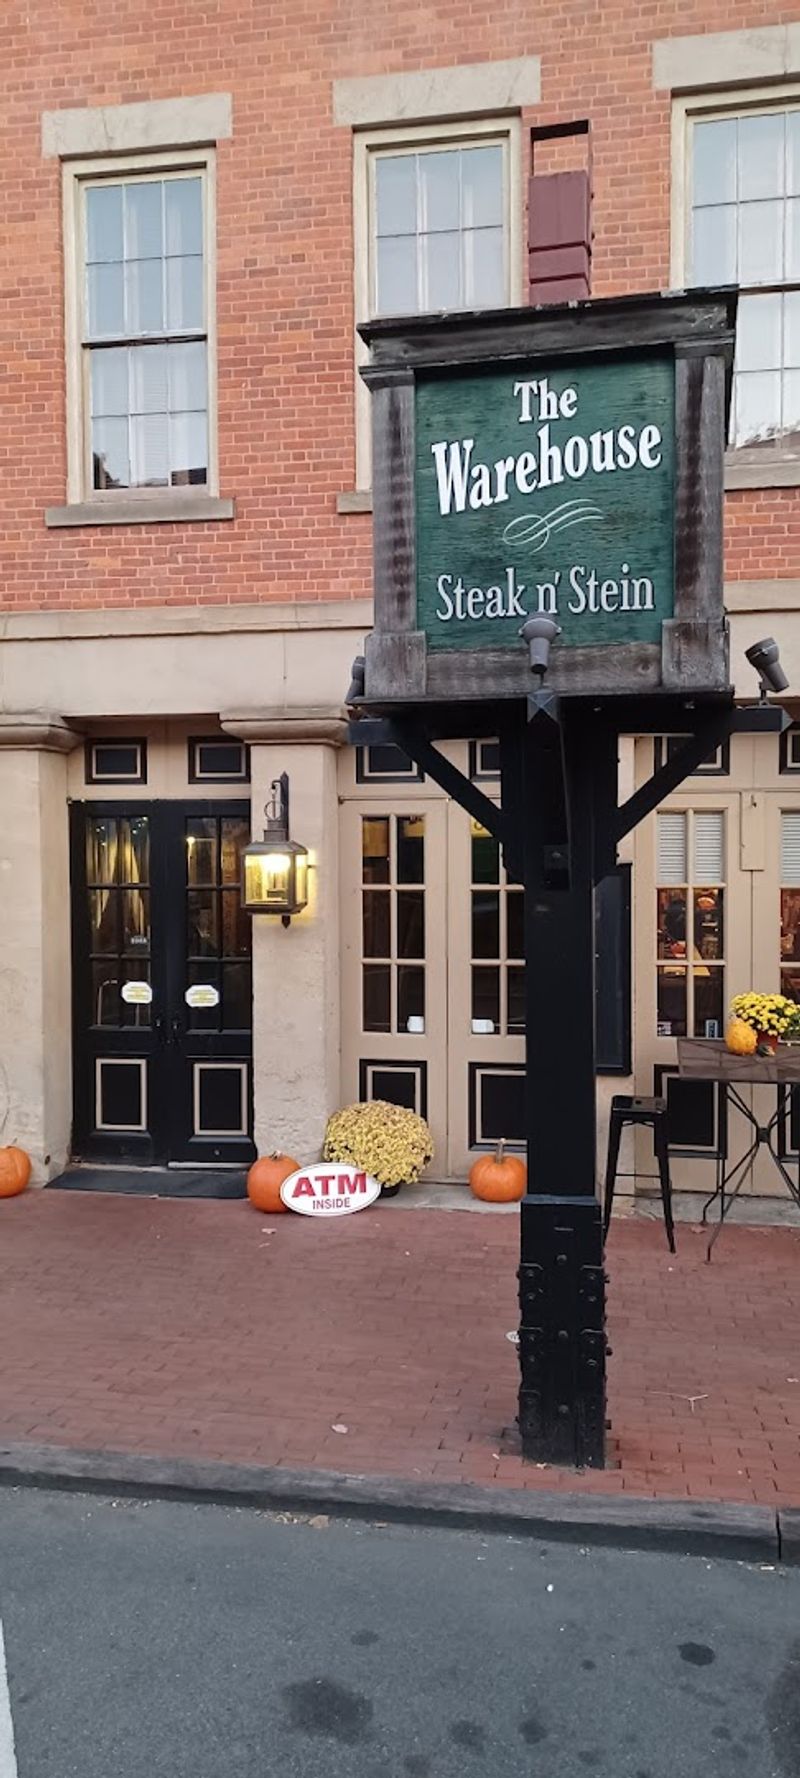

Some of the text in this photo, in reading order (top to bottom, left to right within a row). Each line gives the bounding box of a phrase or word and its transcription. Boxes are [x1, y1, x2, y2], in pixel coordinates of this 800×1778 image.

[513, 378, 578, 423] The
[431, 423, 662, 516] Warehouse
[436, 563, 654, 621] Steak n' Stein
[292, 1172, 367, 1198] ATM
[312, 1197, 352, 1210] INSIDE
